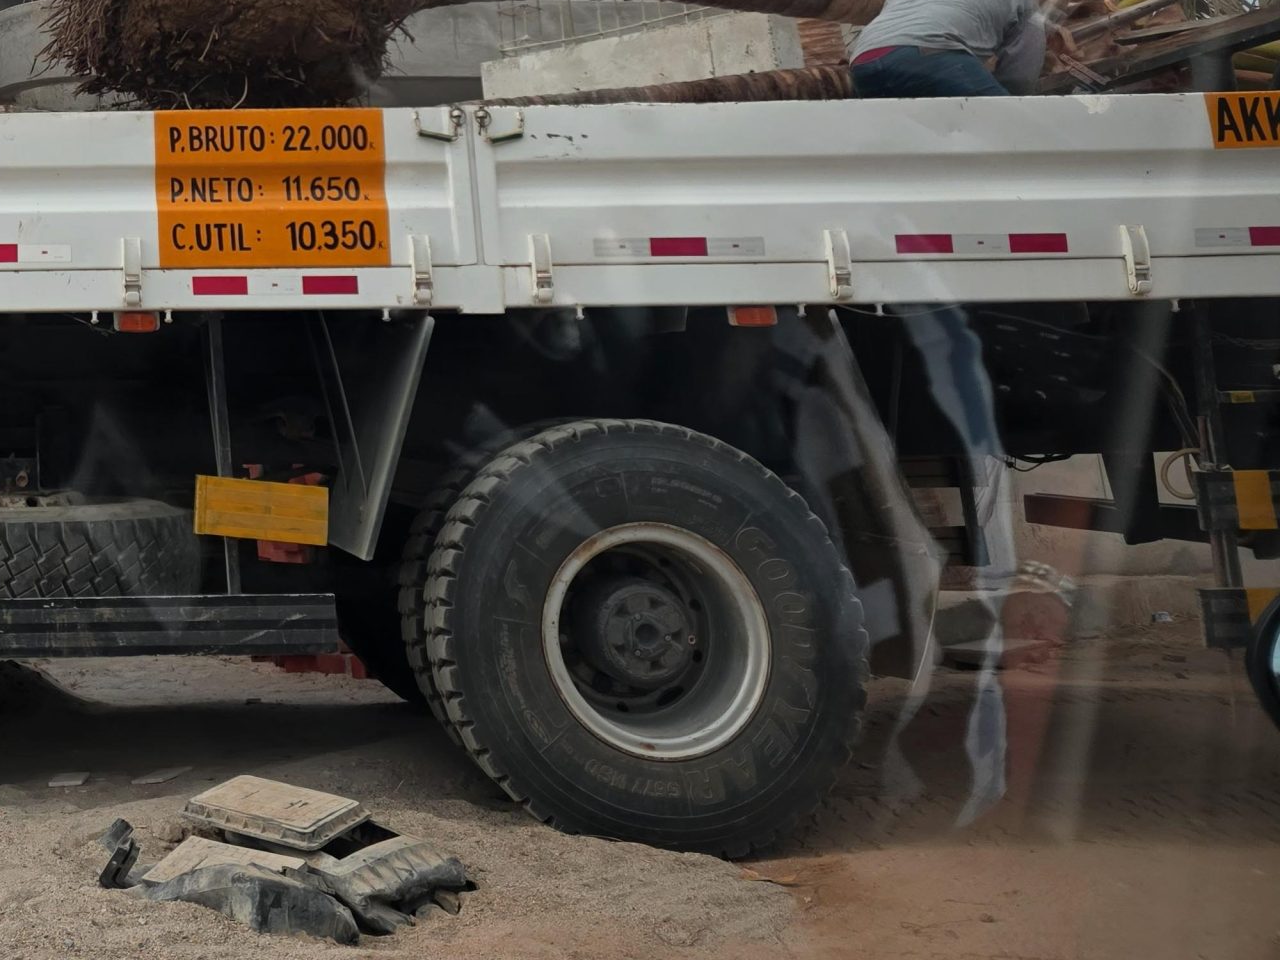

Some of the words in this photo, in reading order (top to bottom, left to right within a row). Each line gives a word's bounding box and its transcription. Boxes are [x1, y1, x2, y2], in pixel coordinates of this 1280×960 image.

[169, 125, 275, 153] P.BRUTO:
[170, 177, 264, 203] P.NETO:
[172, 223, 261, 251] C.UTIL:
